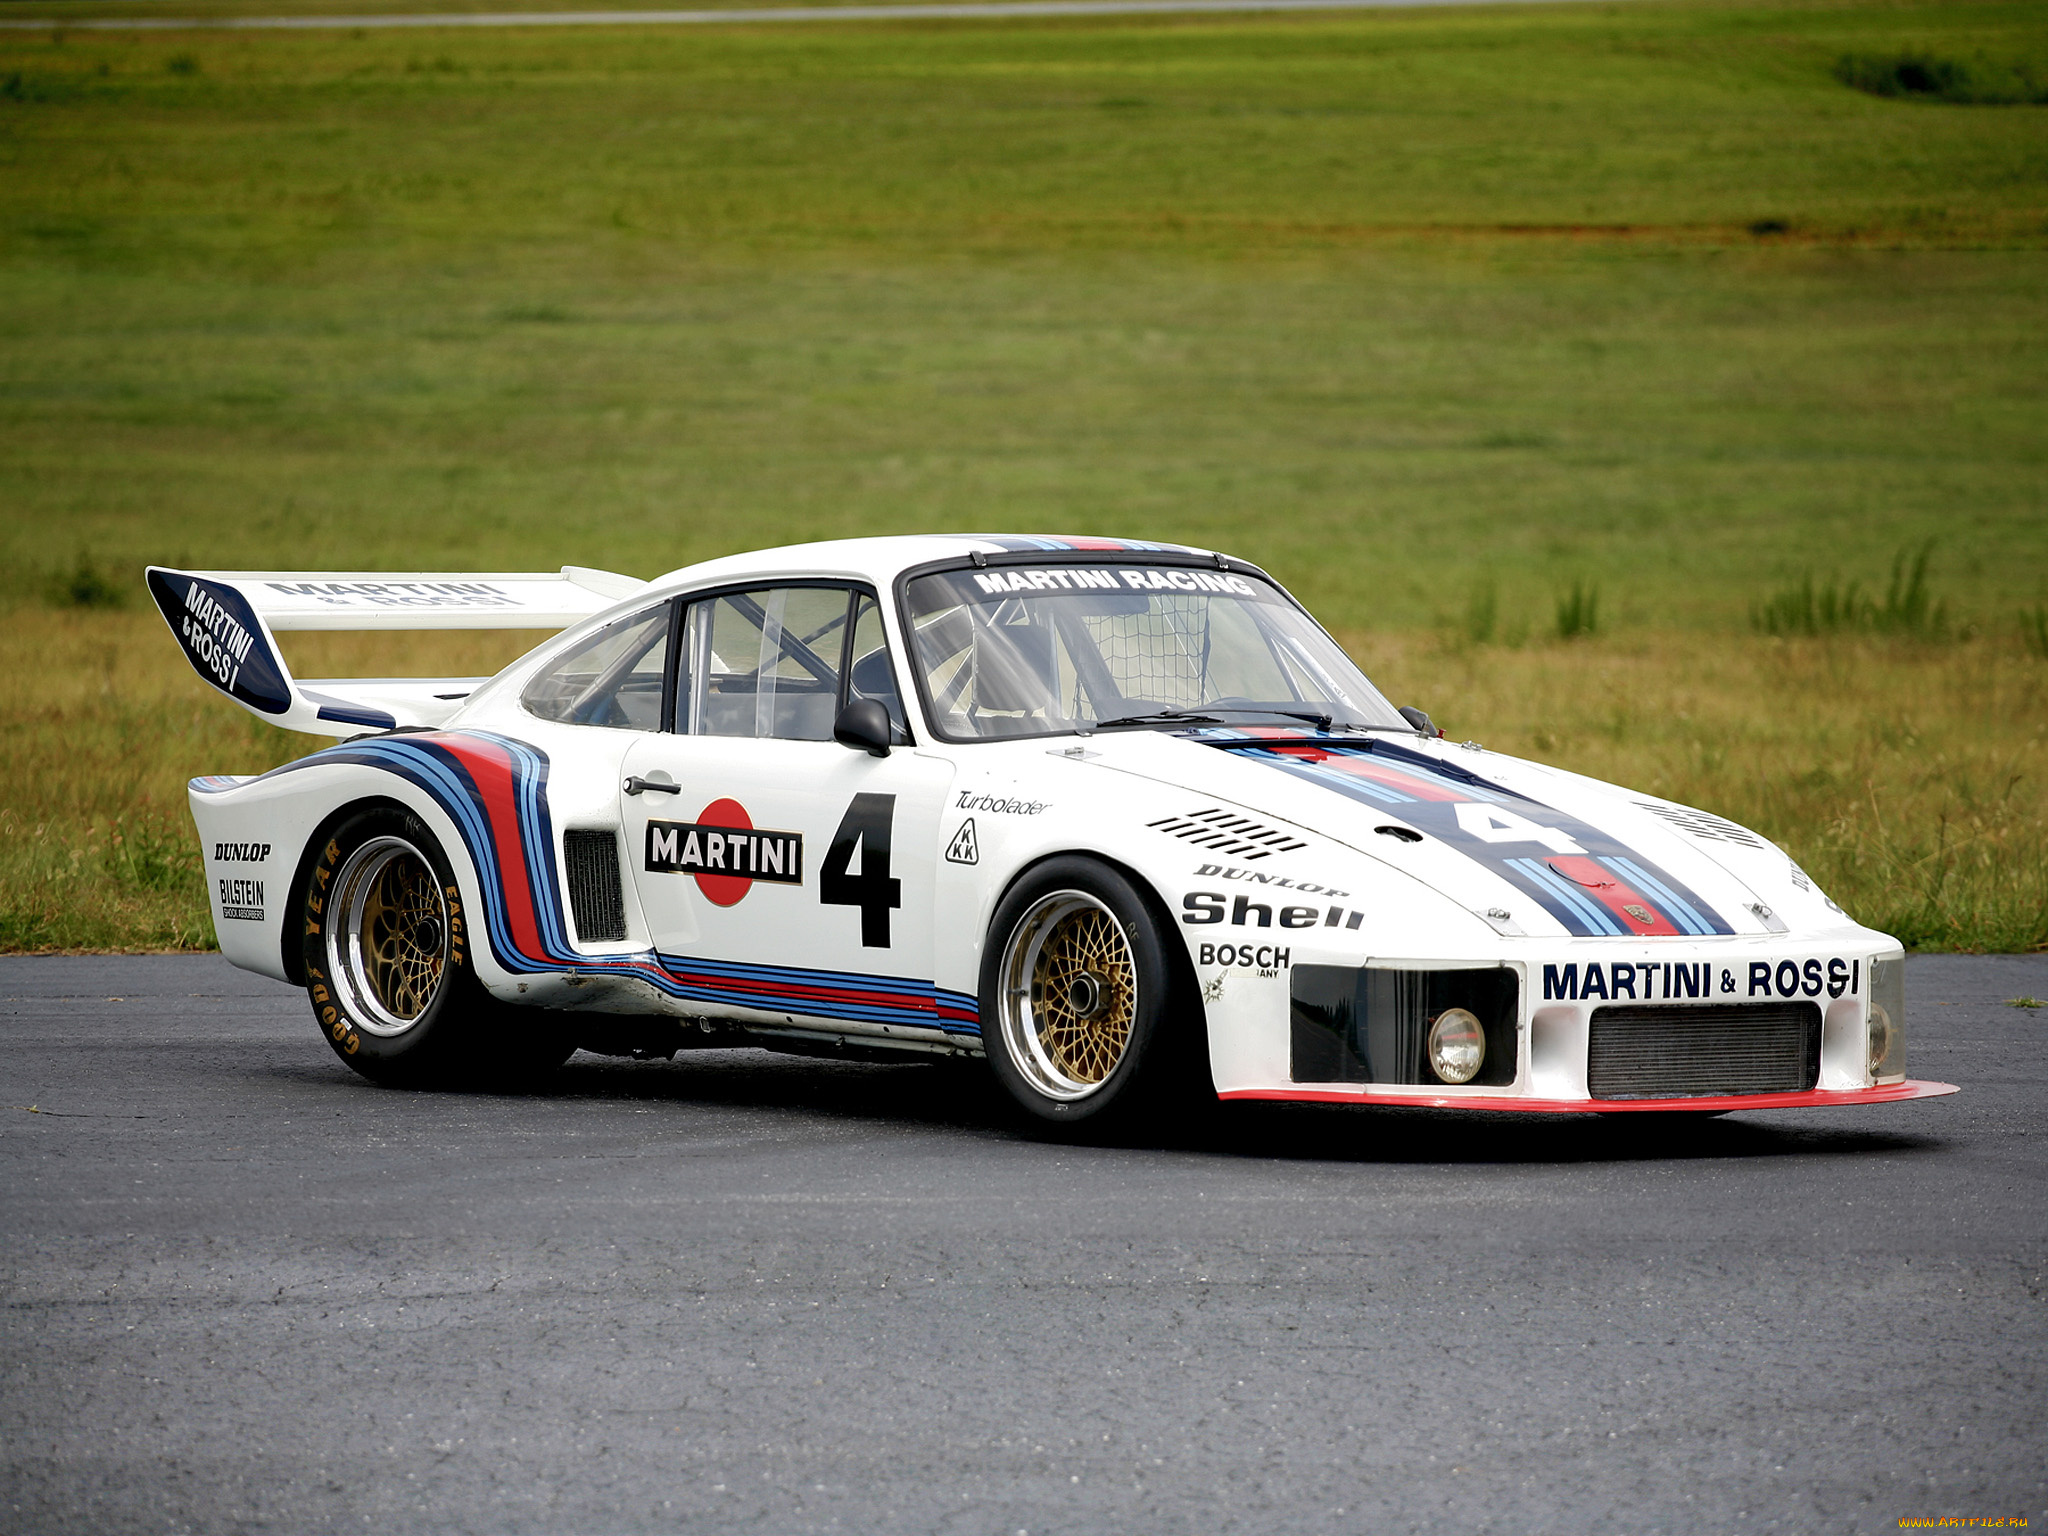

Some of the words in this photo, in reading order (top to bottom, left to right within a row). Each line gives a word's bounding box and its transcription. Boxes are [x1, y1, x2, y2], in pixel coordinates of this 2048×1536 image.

[264, 583, 508, 595] MARTINI
[973, 569, 1121, 594] MARTINI
[1119, 570, 1257, 597] RACING
[362, 596, 525, 606] ROSSI
[185, 581, 254, 664] MARTINI
[183, 615, 190, 636] &
[190, 621, 239, 692] ROSSI
[955, 790, 1053, 815] Turbolader
[1453, 802, 1590, 854] 4
[214, 843, 271, 862] DUNLOP
[651, 826, 797, 876] MARTINI
[820, 792, 901, 949] 4
[1193, 863, 1350, 897] DUNLOP
[219, 879, 264, 906] BILSTEIN
[445, 885, 464, 967] EAGLE
[1182, 891, 1365, 931] Shell
[1200, 942, 1291, 969] BOSCH
[1256, 968, 1280, 978] ANY
[1543, 961, 1711, 1000] MARTINI
[1720, 968, 1736, 994] &
[1748, 957, 1860, 999] ROSSI
